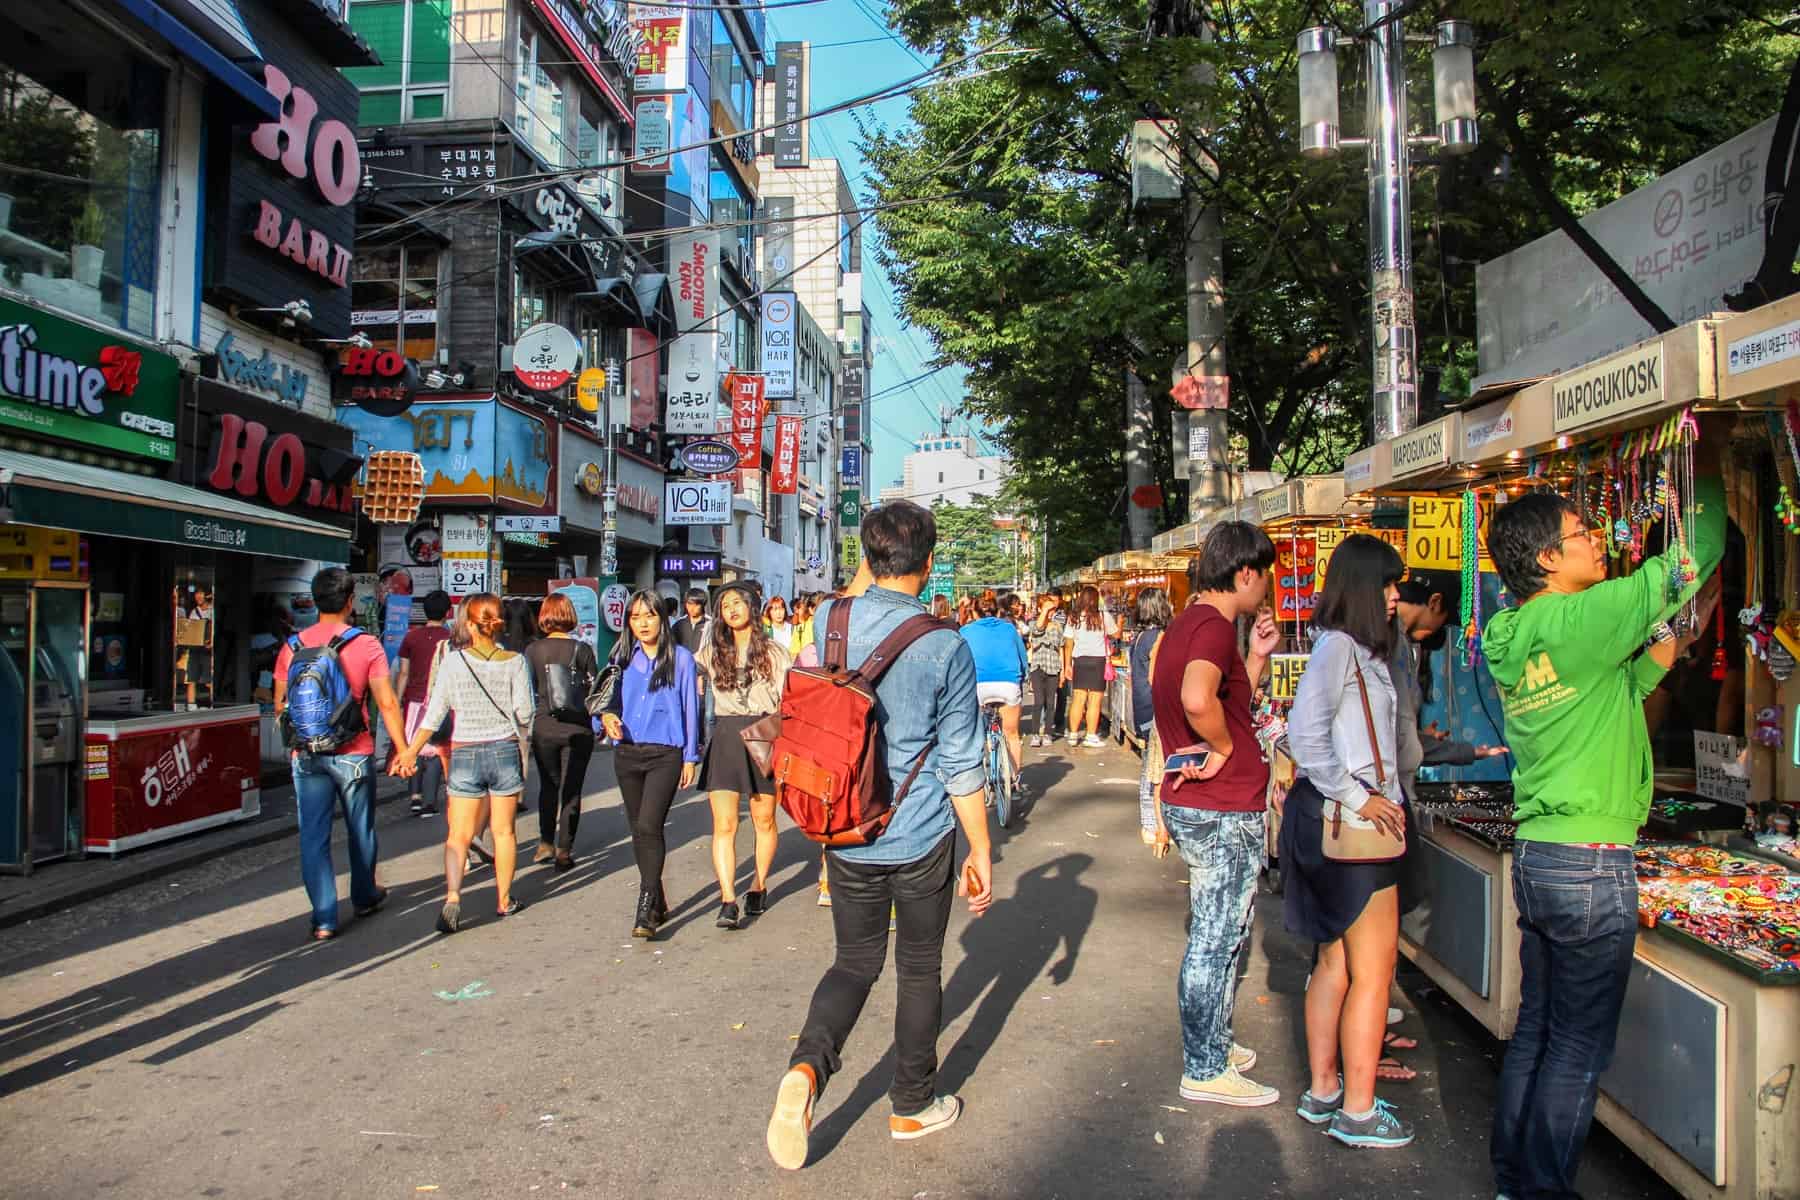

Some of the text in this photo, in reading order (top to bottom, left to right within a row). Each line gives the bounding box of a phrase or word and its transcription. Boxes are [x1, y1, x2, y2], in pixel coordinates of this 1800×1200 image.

[440, 149, 497, 163] 부대찌개
[678, 260, 693, 303] KING
[691, 241, 709, 320] SMOOTHIE
[765, 329, 791, 348] VOG
[767, 350, 789, 361] HAIR
[341, 348, 404, 376] HO
[1556, 356, 1659, 421] MAPOGUKIOSK
[739, 381, 759, 448] 피자마루
[208, 413, 305, 507] HO
[779, 421, 798, 480] 피자마루
[450, 573, 485, 594] 은서
